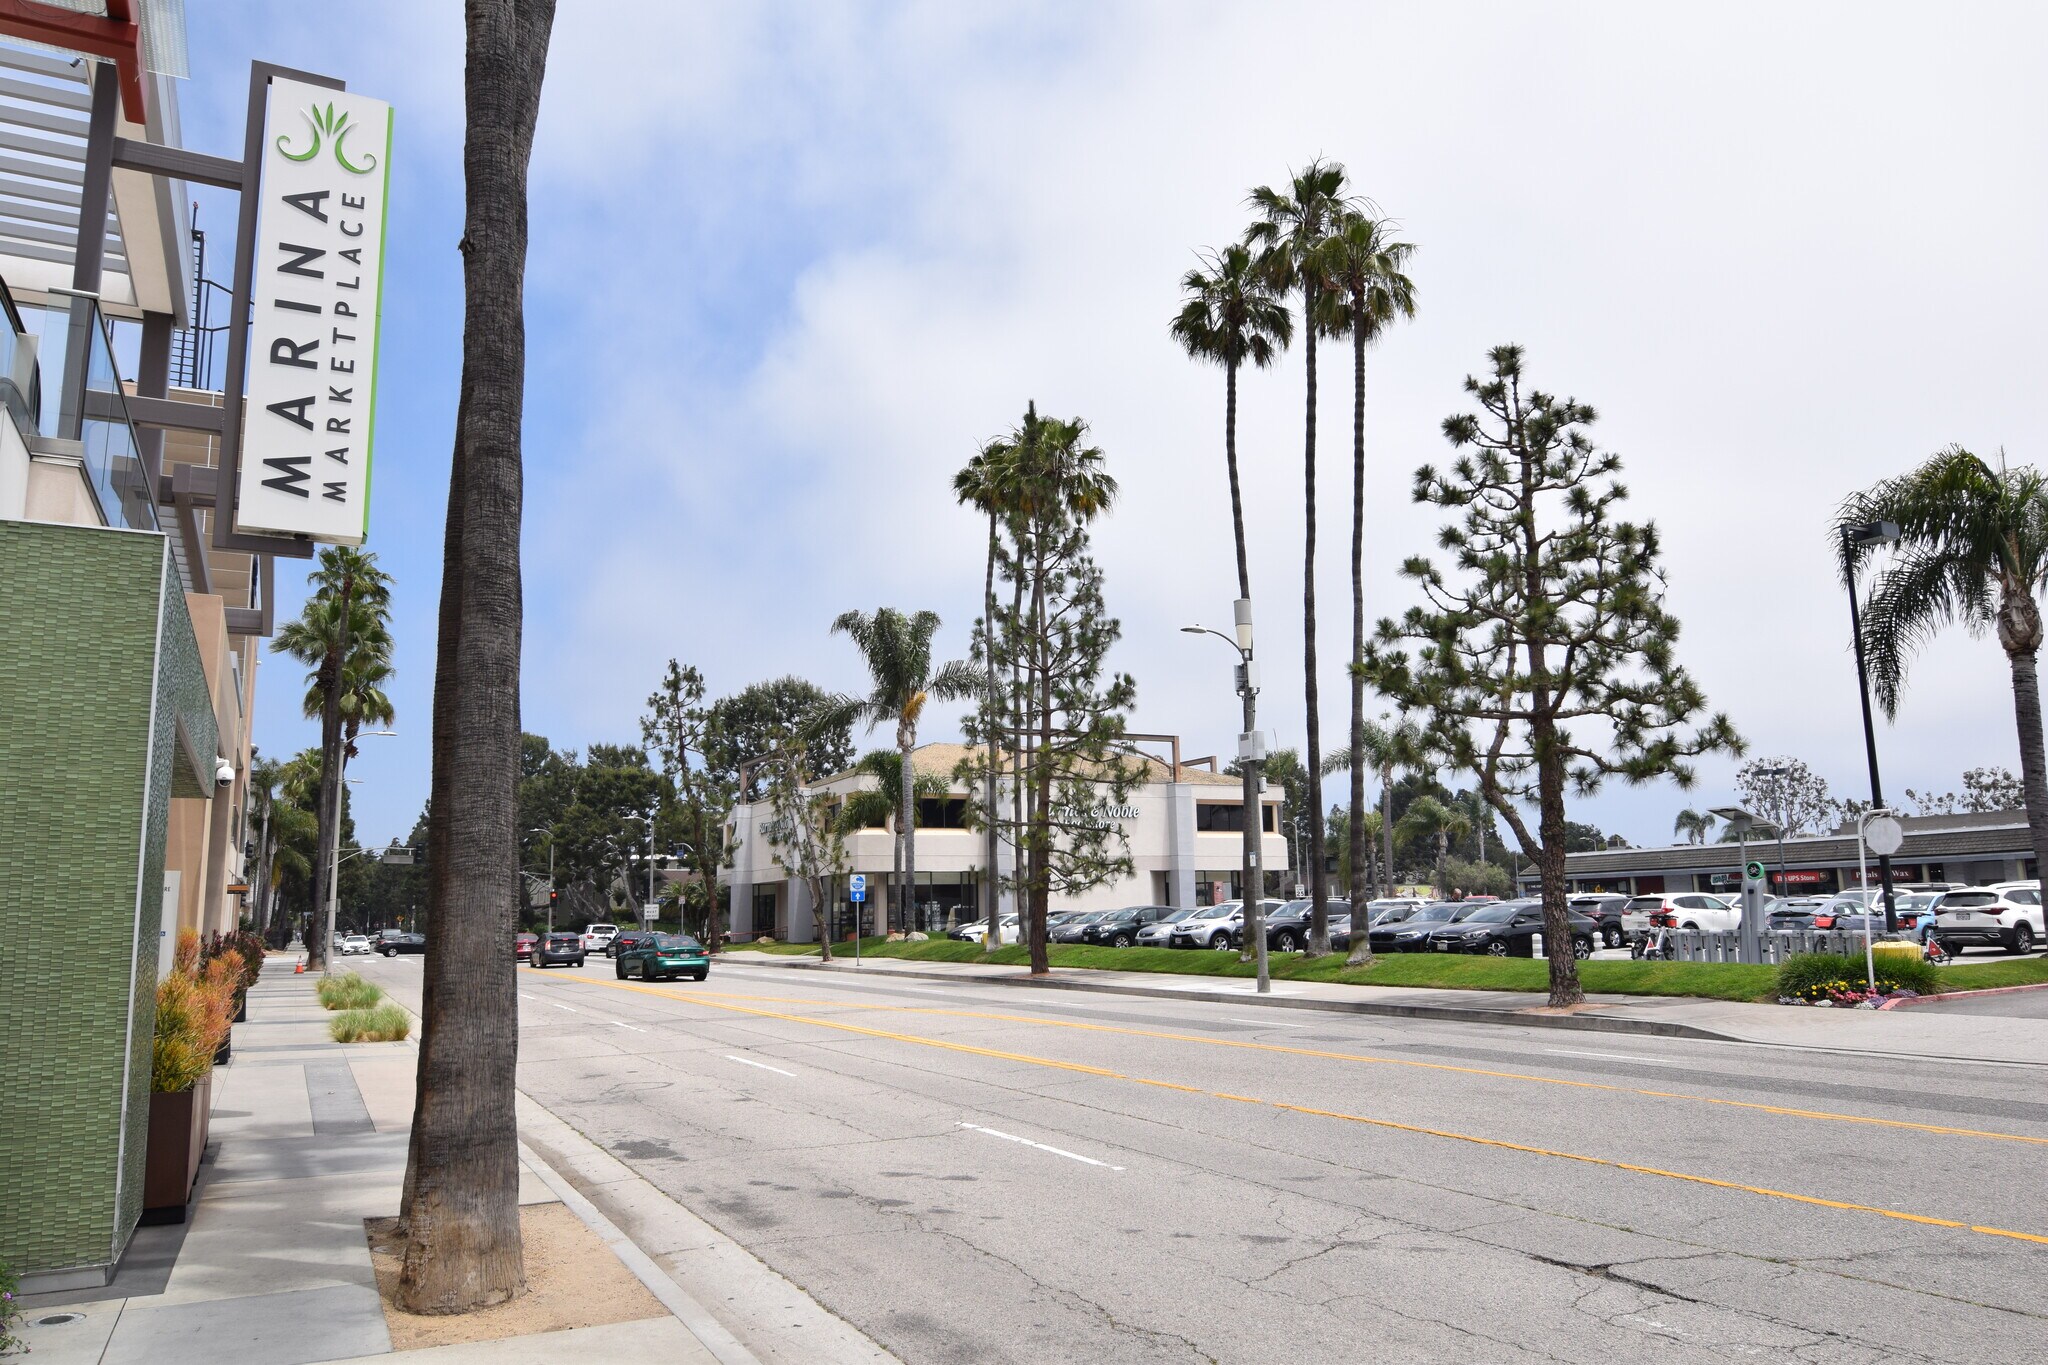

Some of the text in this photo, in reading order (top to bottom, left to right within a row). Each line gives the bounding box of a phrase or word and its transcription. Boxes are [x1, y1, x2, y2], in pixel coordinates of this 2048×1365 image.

[261, 190, 330, 499] MARINA
[322, 192, 365, 503] MARKETPLACE
[1090, 806, 1099, 818] &
[1103, 805, 1140, 819] Noble
[1856, 871, 1878, 879] Pals
